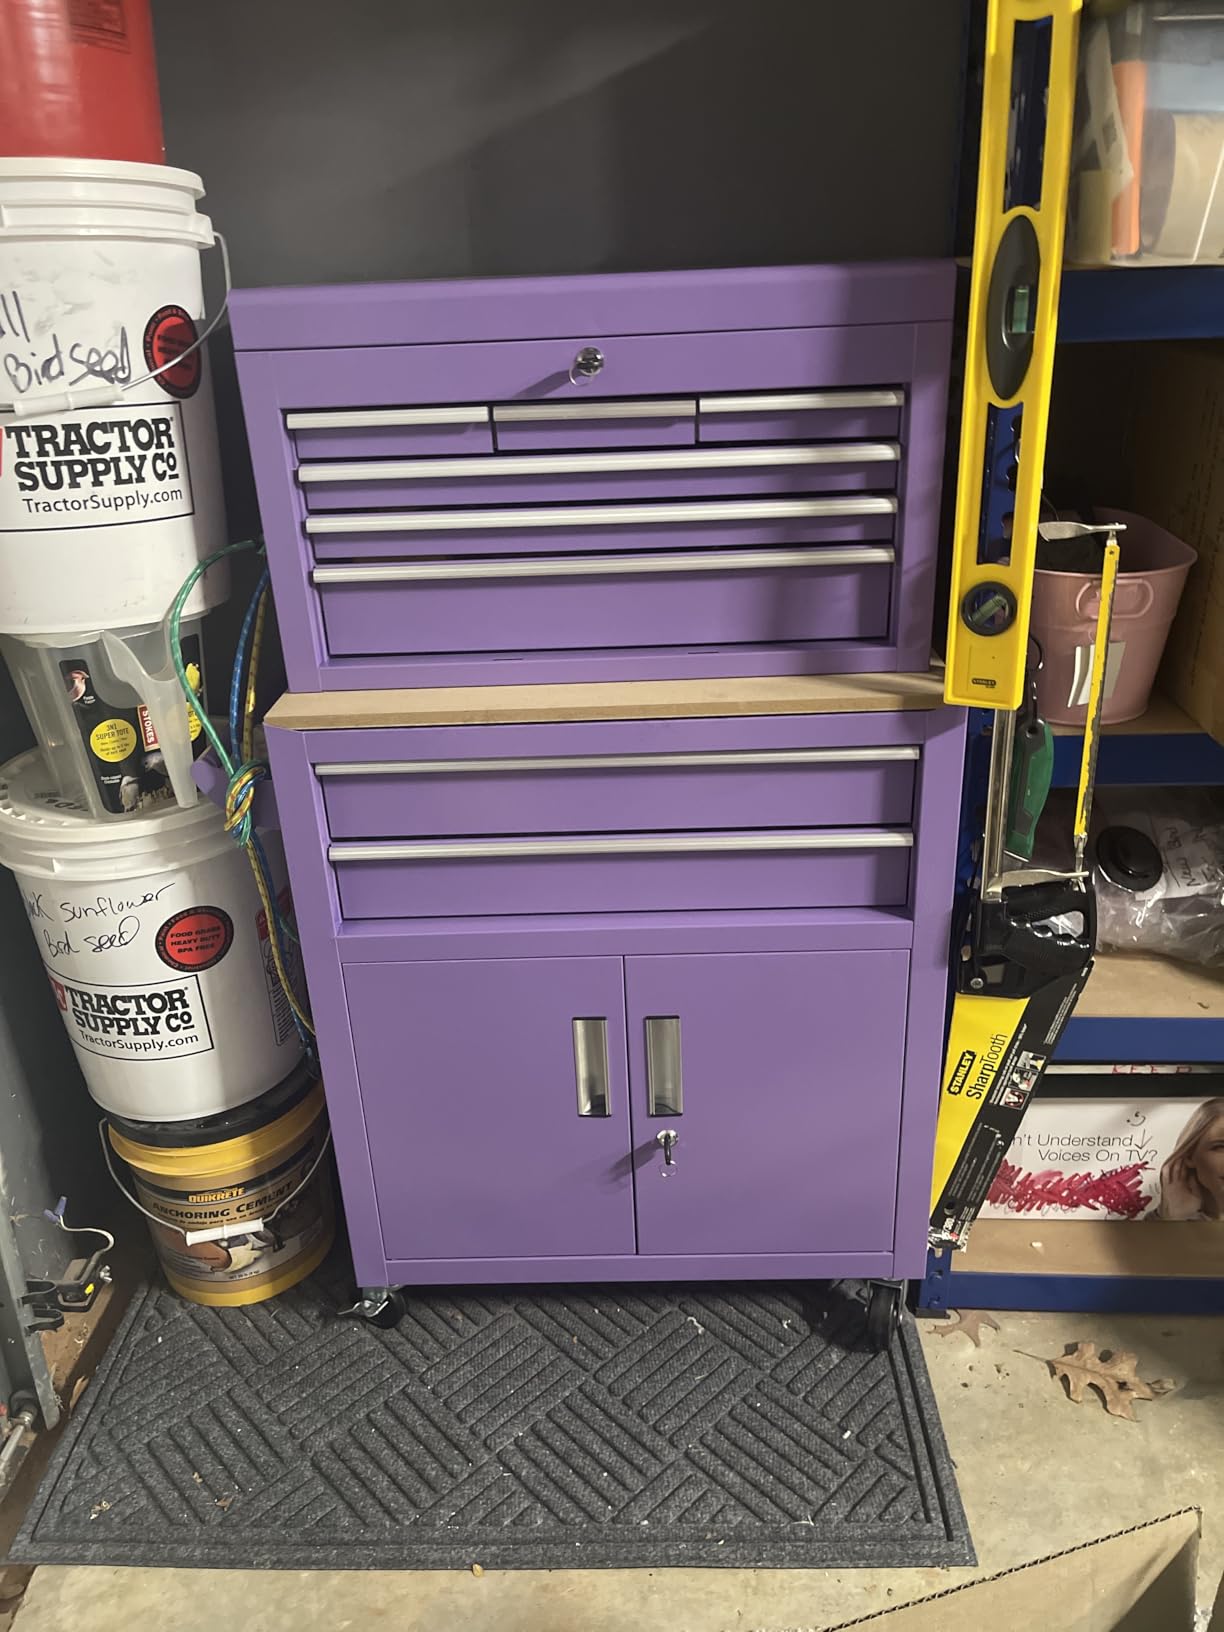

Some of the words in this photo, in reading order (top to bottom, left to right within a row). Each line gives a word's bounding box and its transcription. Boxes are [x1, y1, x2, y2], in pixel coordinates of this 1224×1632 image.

[4, 333, 64, 393] Bird
[5, 417, 174, 459] TRACTOR
[14, 454, 147, 492] SUPPLY
[22, 488, 183, 514] TractorSupply.com
[142, 710, 155, 743] STOKES
[170, 938, 198, 946] HEAVY
[64, 984, 190, 1016] TRACTOR
[73, 1007, 161, 1036] SUPPLY
[79, 1029, 199, 1052] TractorSupply.com
[949, 1052, 974, 1094] STANLEY
[966, 1033, 1009, 1100] SharpTooth
[1012, 1133, 1032, 1146] n't
[1037, 1132, 1133, 1146] Understand
[1038, 1148, 1091, 1162] Voices
[1095, 1149, 1120, 1162] On
[1126, 1149, 1158, 1162] TV?
[153, 1202, 231, 1219] ANCHORING
[236, 1182, 292, 1213] CEMENT
[188, 1187, 245, 1203] QUIKRETE
